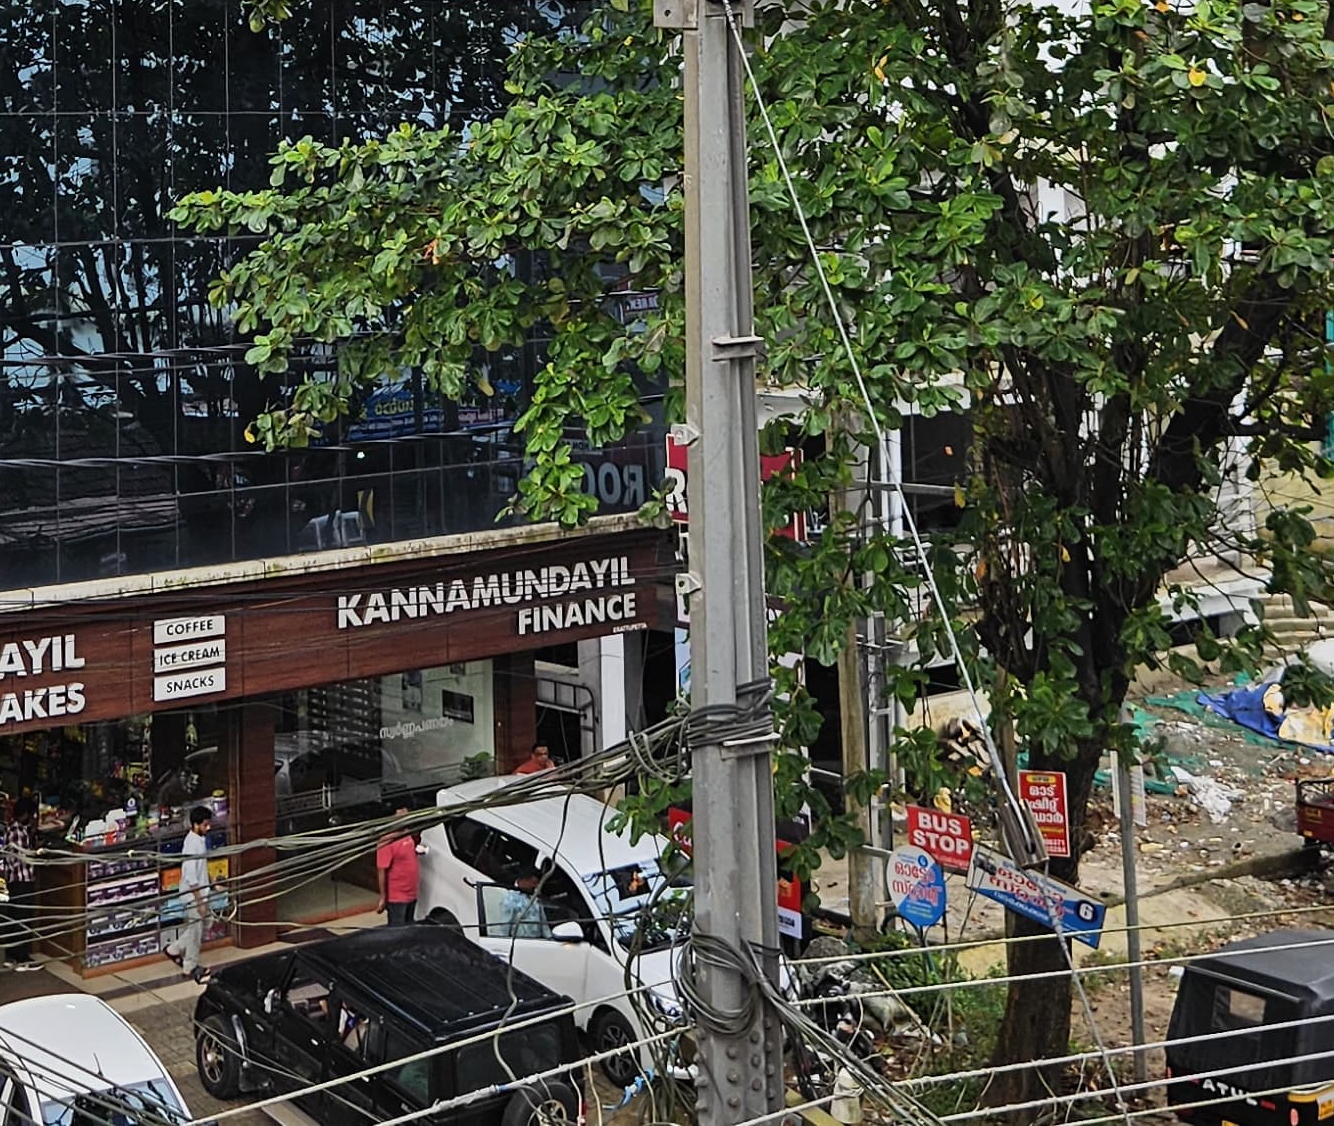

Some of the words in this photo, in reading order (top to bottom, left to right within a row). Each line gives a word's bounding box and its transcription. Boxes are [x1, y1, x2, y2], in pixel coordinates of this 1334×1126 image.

[337, 556, 636, 630] KANNAMUNDAYIL
[518, 592, 637, 635] FINANCE
[166, 619, 214, 636] COFFEE
[159, 653, 178, 667] ICE
[180, 646, 221, 662] CREAM
[166, 674, 215, 694] SNACKS
[917, 811, 963, 835] BUS
[912, 829, 970, 856] STOP
[1078, 901, 1094, 921] 6
